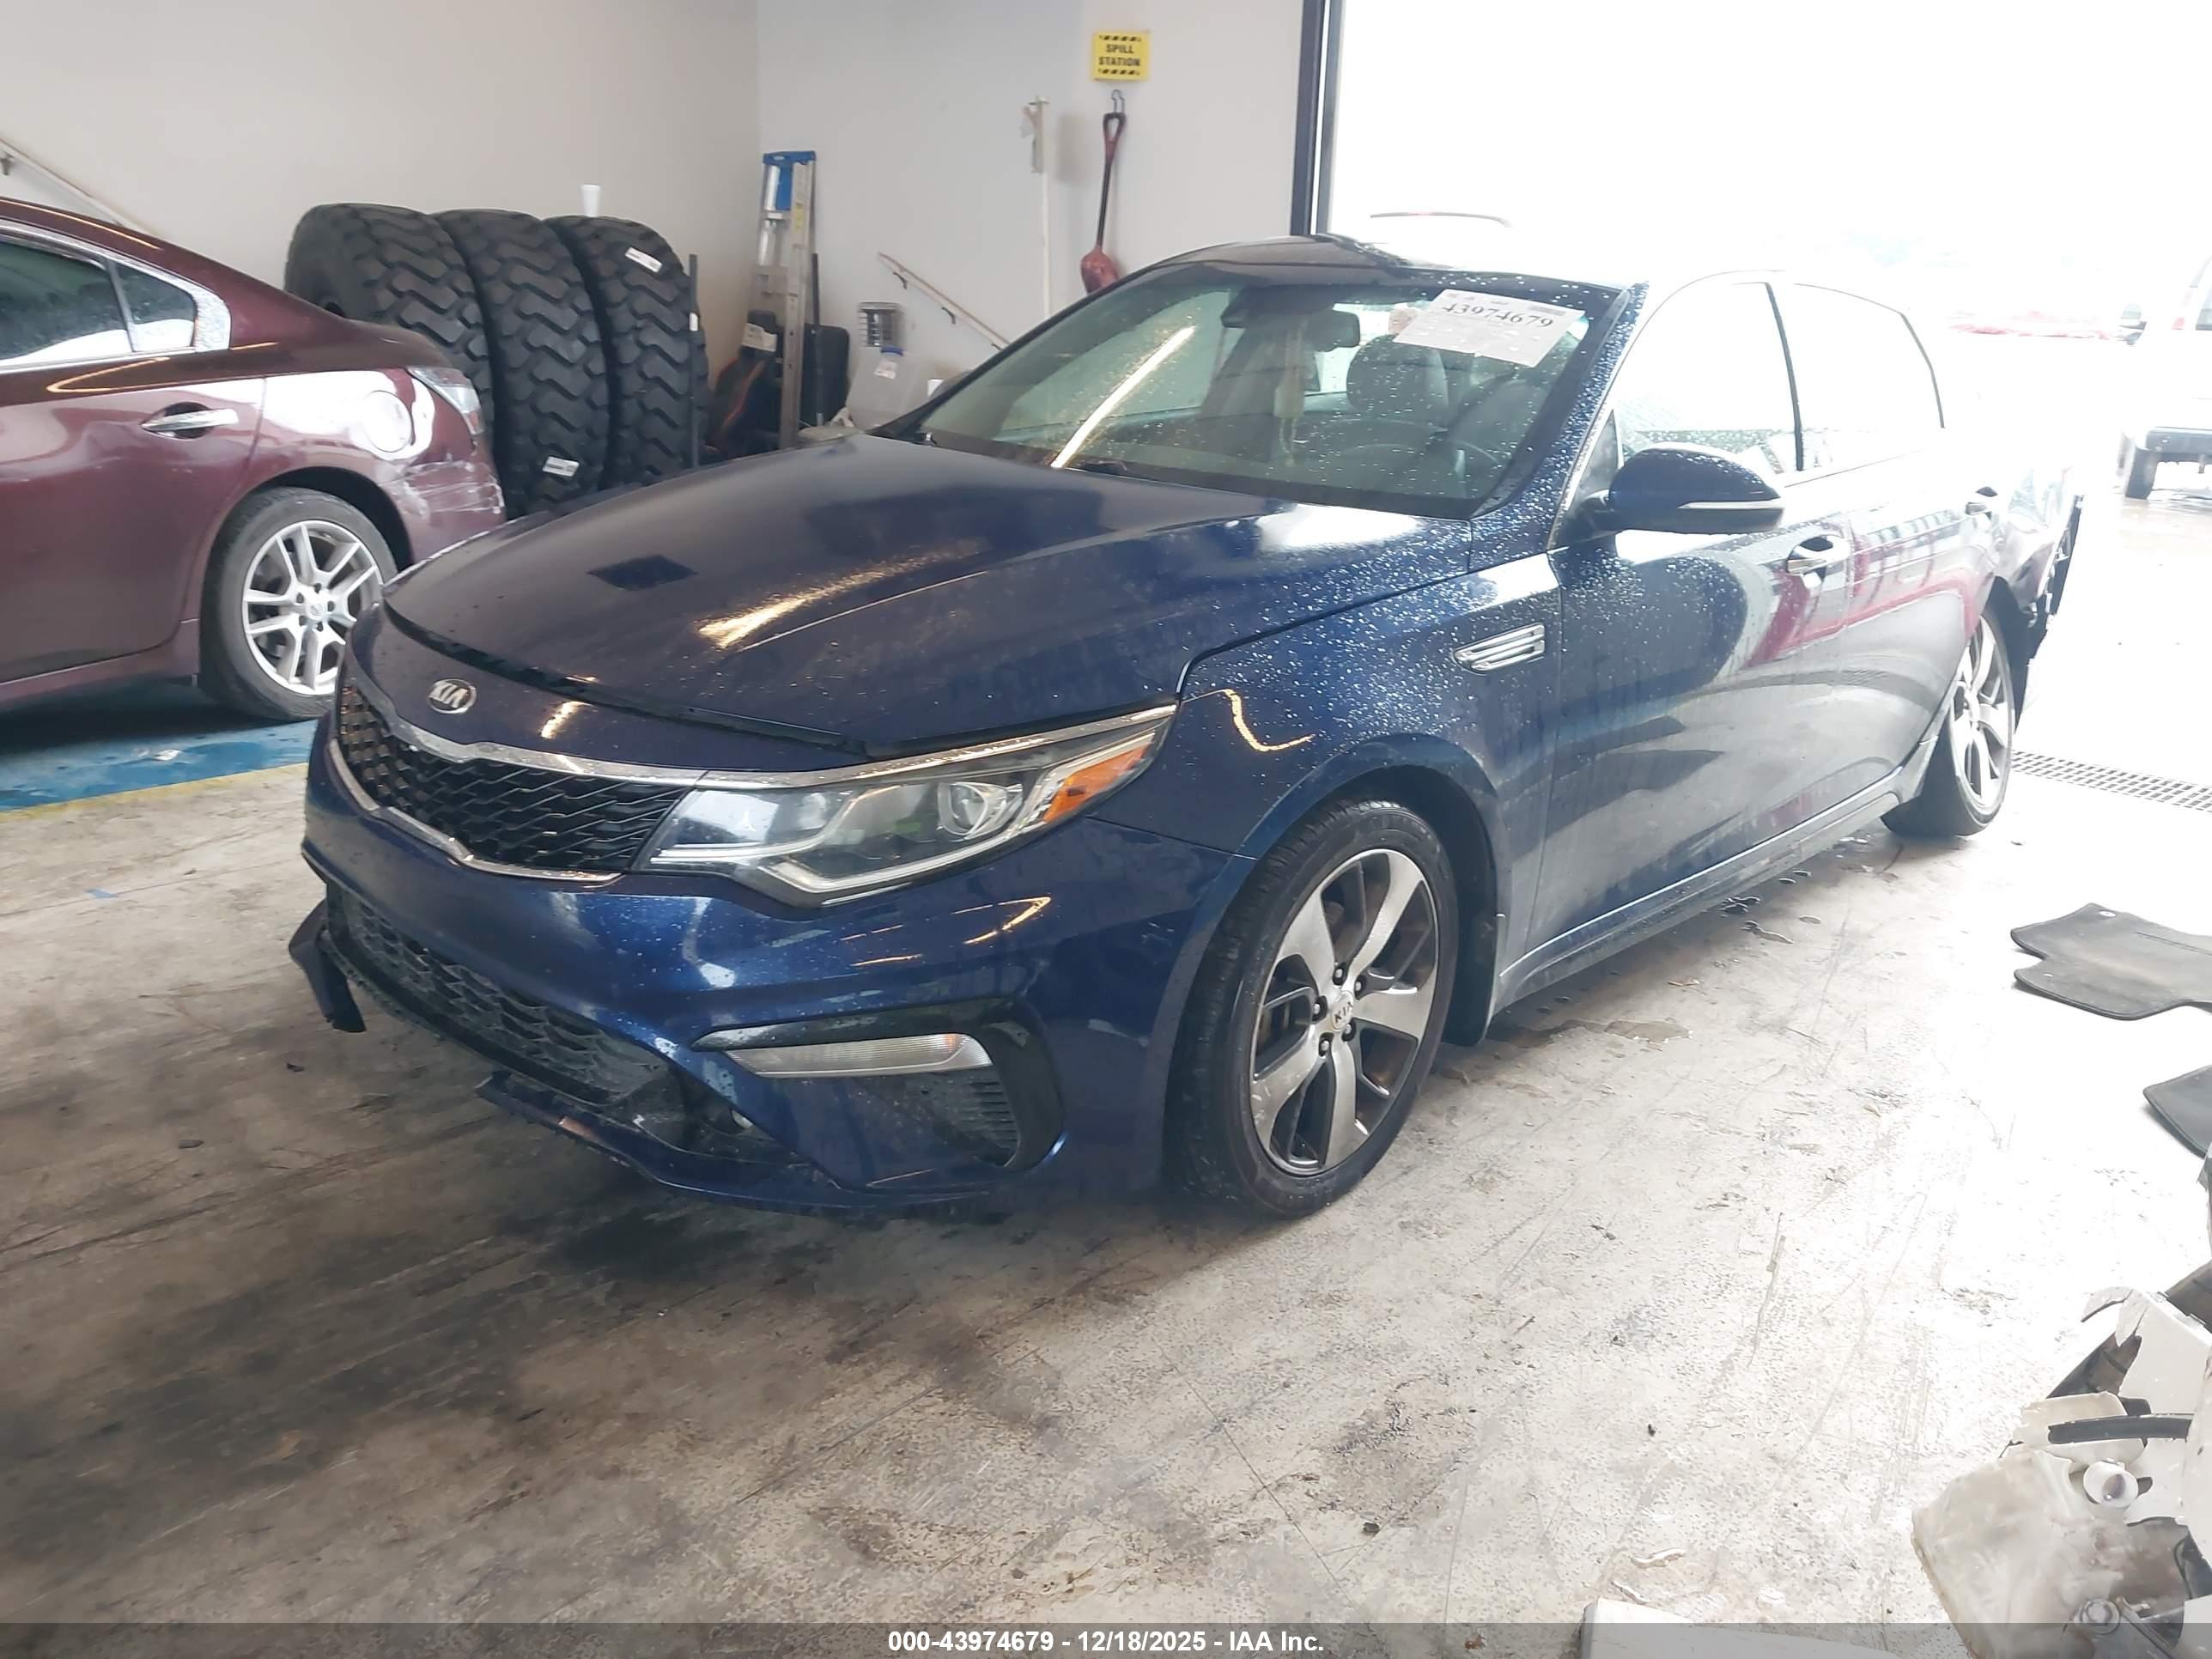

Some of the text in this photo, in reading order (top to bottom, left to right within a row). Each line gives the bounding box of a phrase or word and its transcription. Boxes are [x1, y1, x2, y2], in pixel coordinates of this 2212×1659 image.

[1105, 44, 1134, 54] SPILL
[1098, 57, 1140, 66] STATION
[1442, 302, 1553, 327] 43974679
[428, 681, 469, 708] KIA
